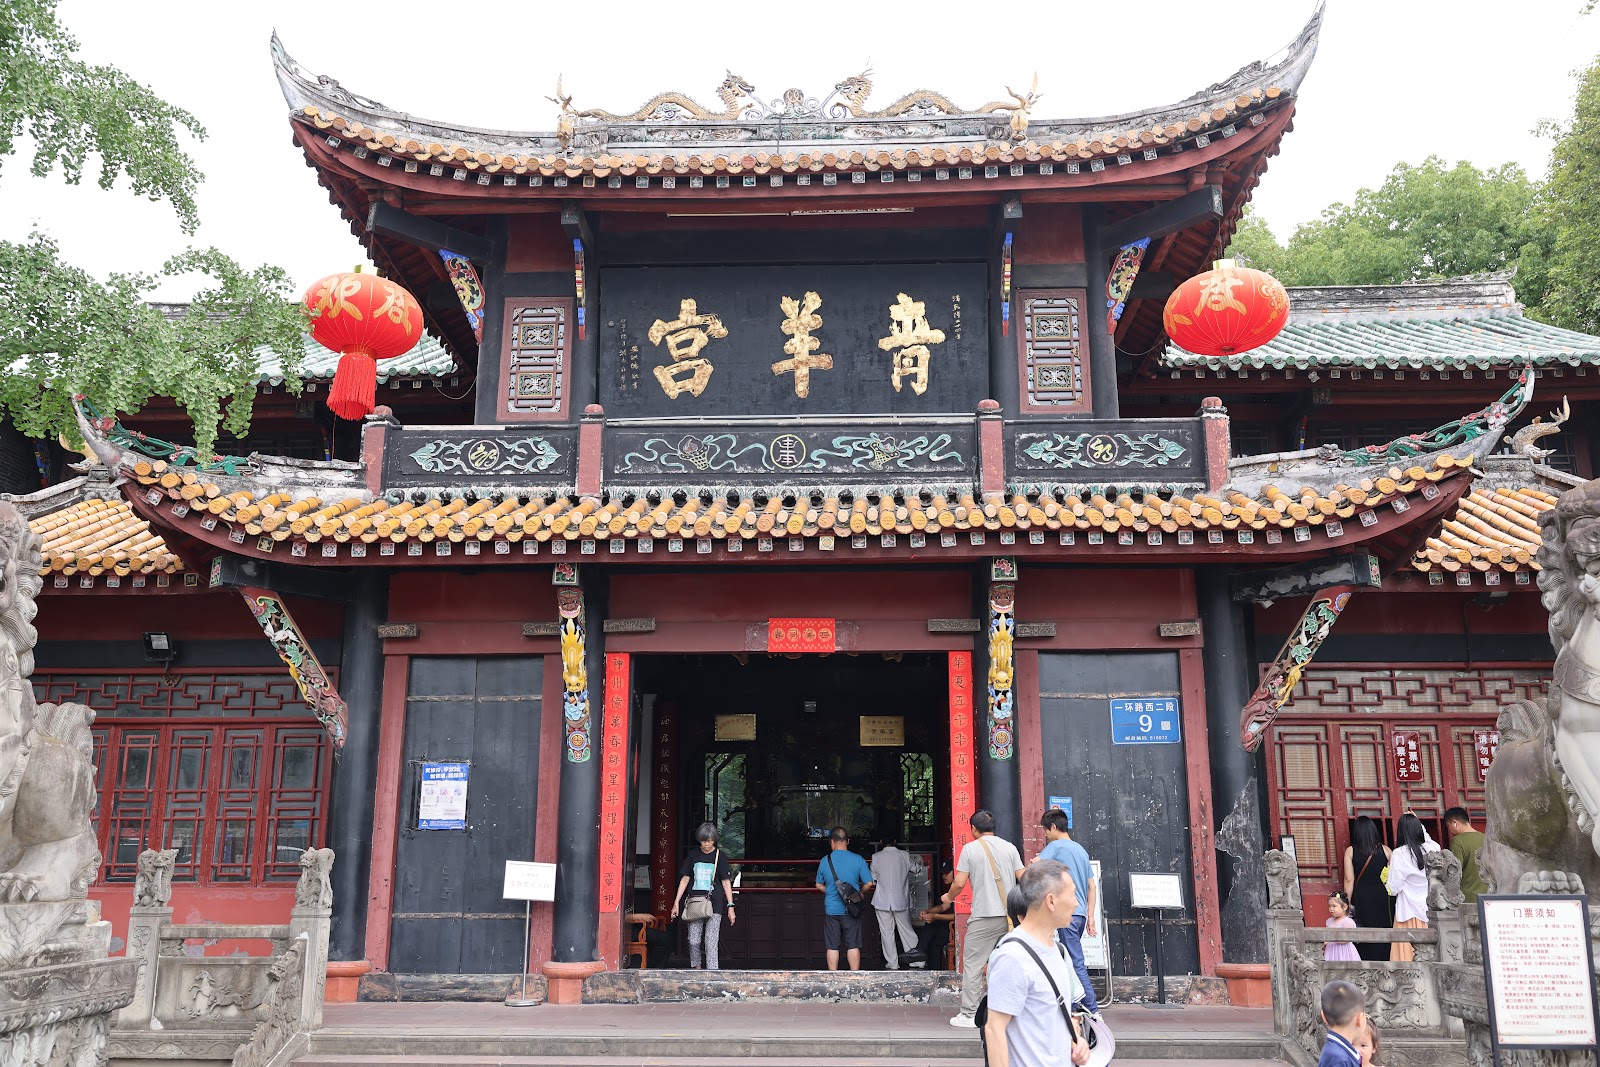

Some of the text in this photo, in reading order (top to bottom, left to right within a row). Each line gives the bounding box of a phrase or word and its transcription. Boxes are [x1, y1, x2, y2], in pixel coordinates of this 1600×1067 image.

[1115, 702, 1175, 712] 一环路西二段
[1139, 714, 1152, 733] 9
[1395, 735, 1408, 778] 门票5元
[1408, 740, 1419, 773] 售票处
[1513, 907, 1556, 918] 门票须知
